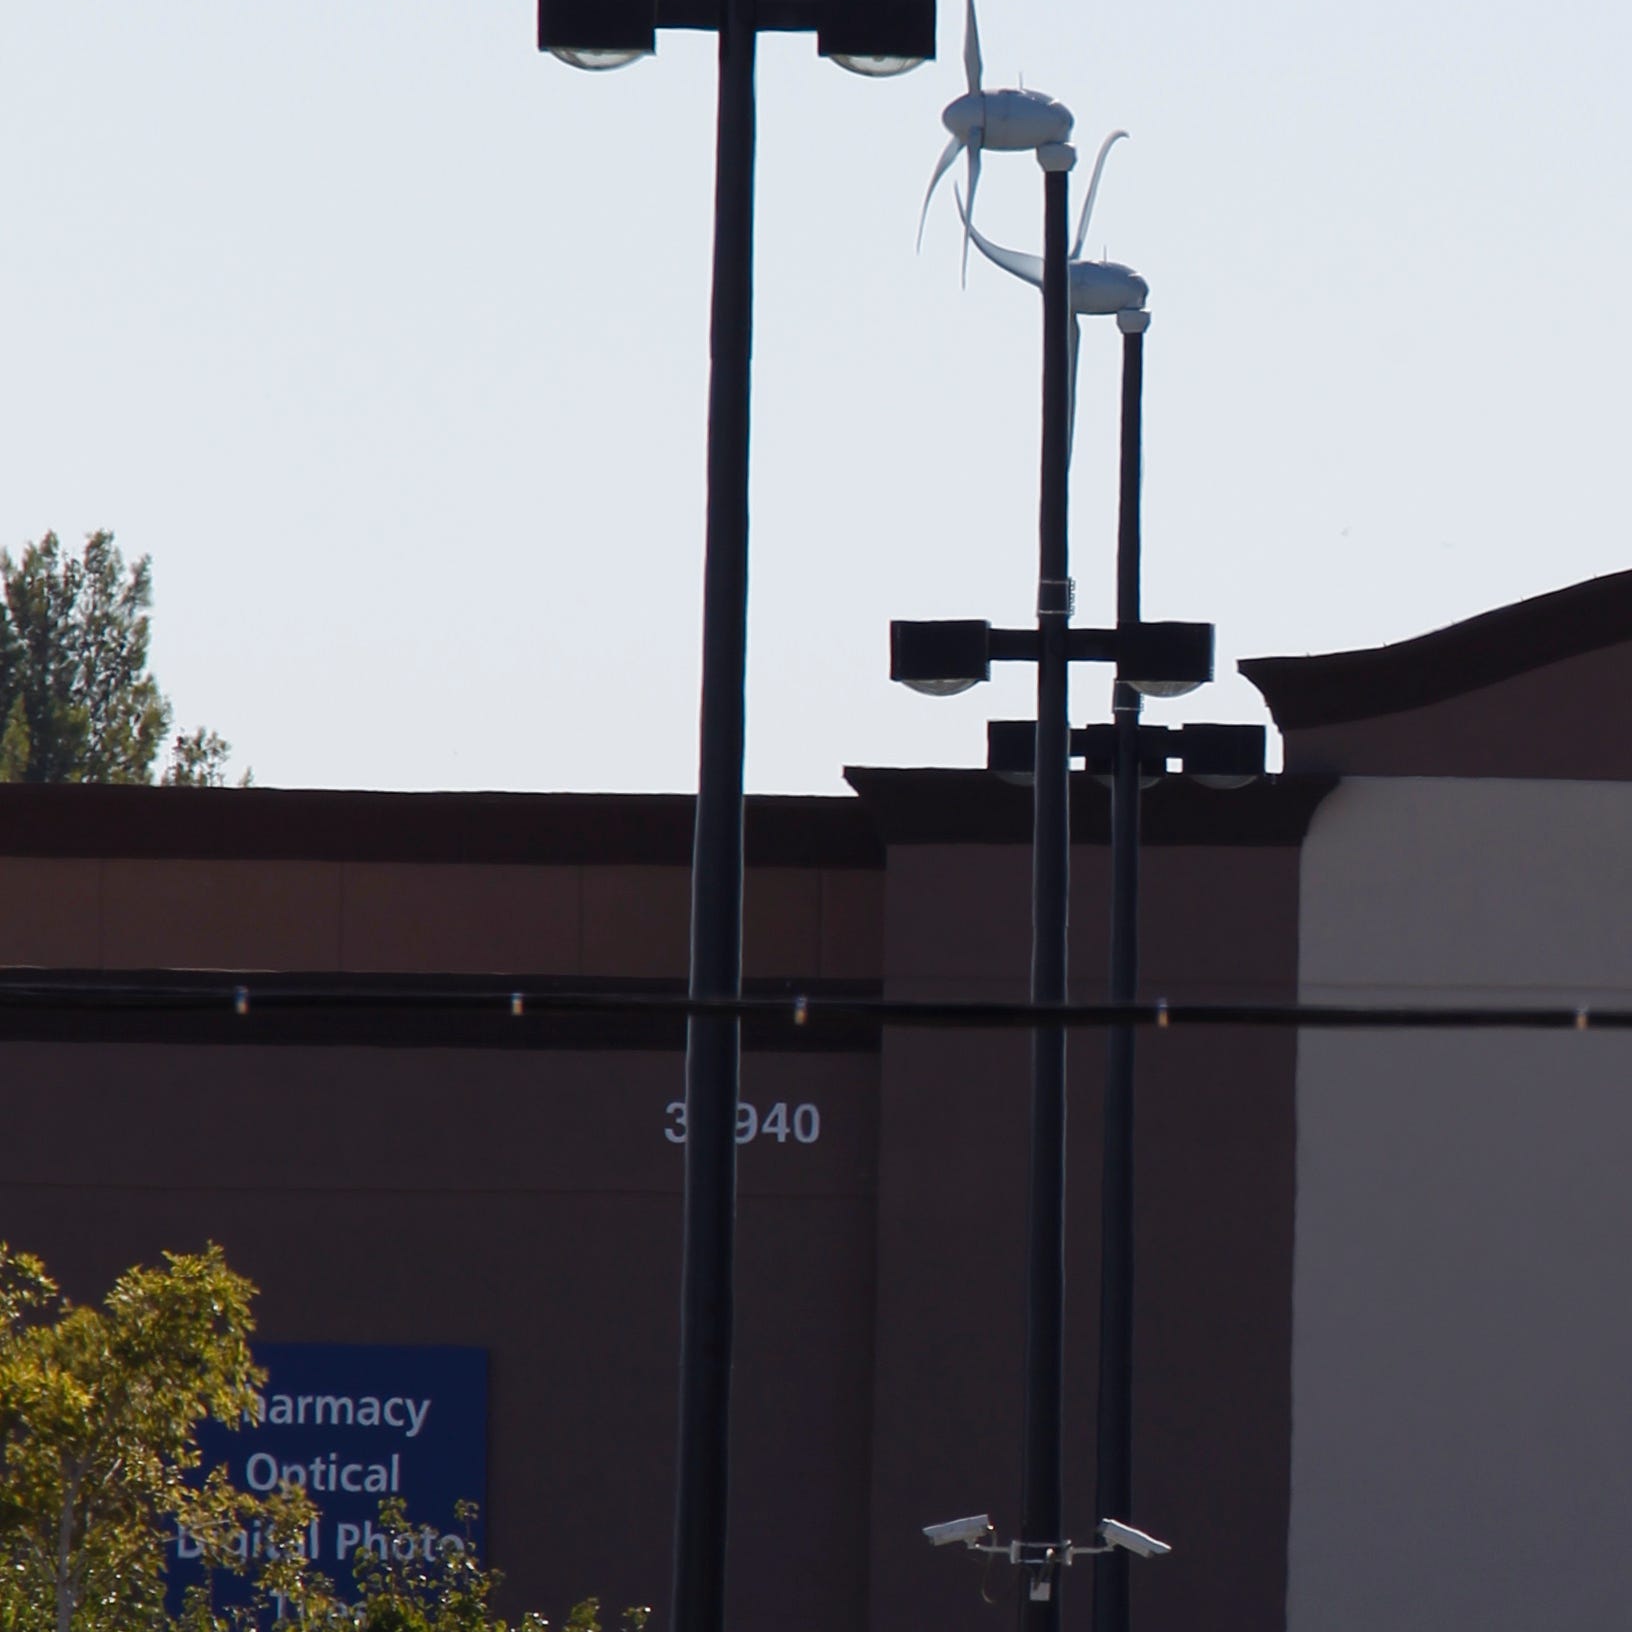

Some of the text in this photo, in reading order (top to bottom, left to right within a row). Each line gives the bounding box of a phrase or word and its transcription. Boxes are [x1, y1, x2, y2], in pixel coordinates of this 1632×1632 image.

[663, 1102, 821, 1144] 3940
[216, 1384, 432, 1437] harmacy
[245, 1451, 401, 1494] Optical
